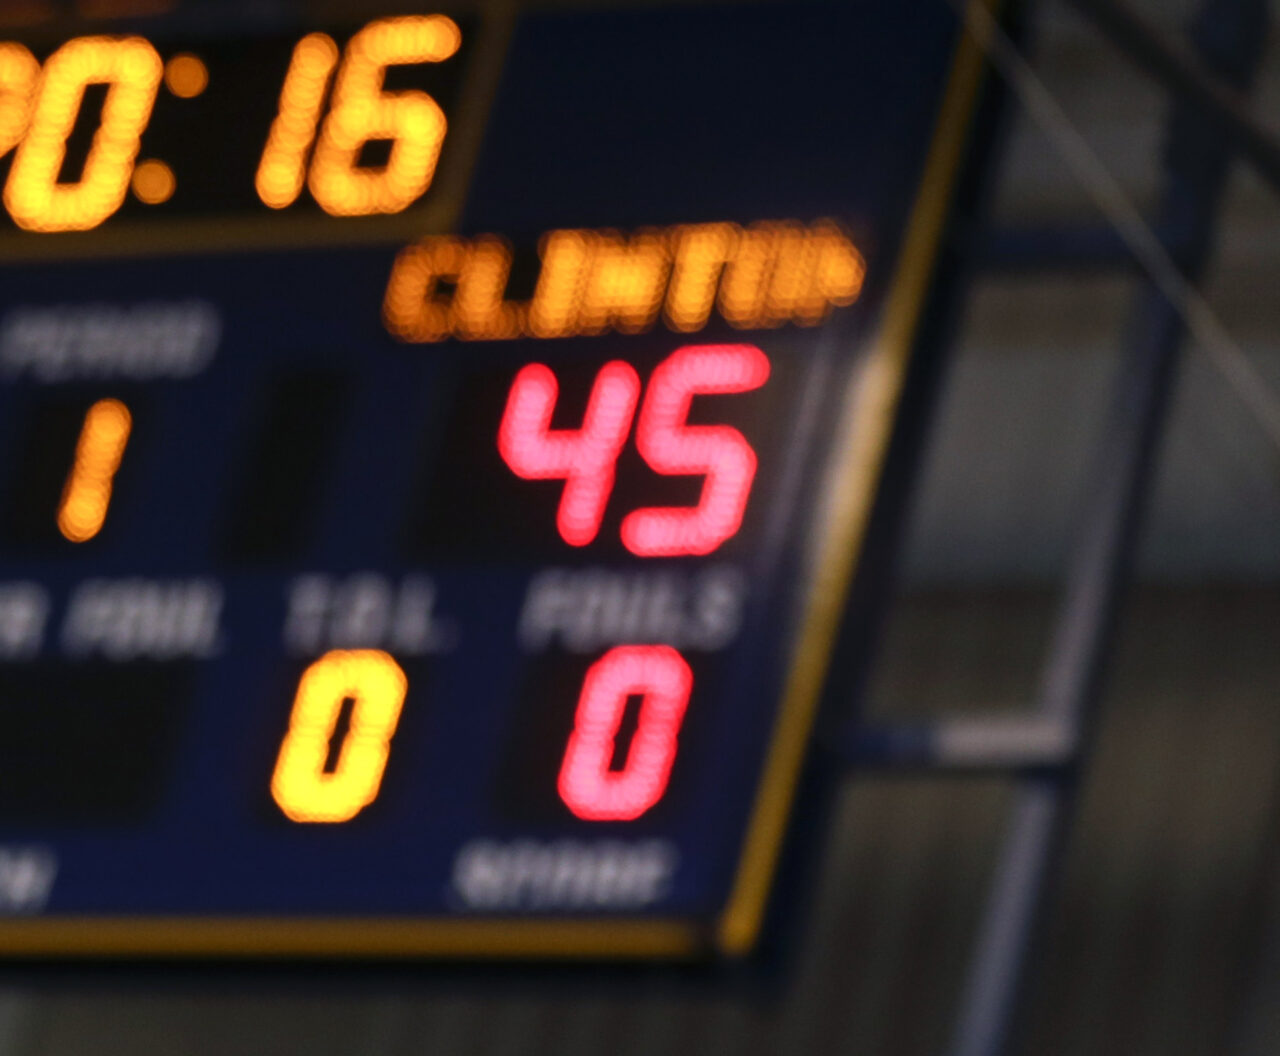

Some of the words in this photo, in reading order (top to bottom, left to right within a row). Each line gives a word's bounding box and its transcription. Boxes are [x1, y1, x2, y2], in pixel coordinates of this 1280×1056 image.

[58, 398, 131, 542] 1
[498, 343, 770, 557] 45
[60, 578, 224, 660] FOUL
[520, 568, 742, 652] FOULS
[271, 649, 407, 823] 0
[557, 645, 693, 821] 0
